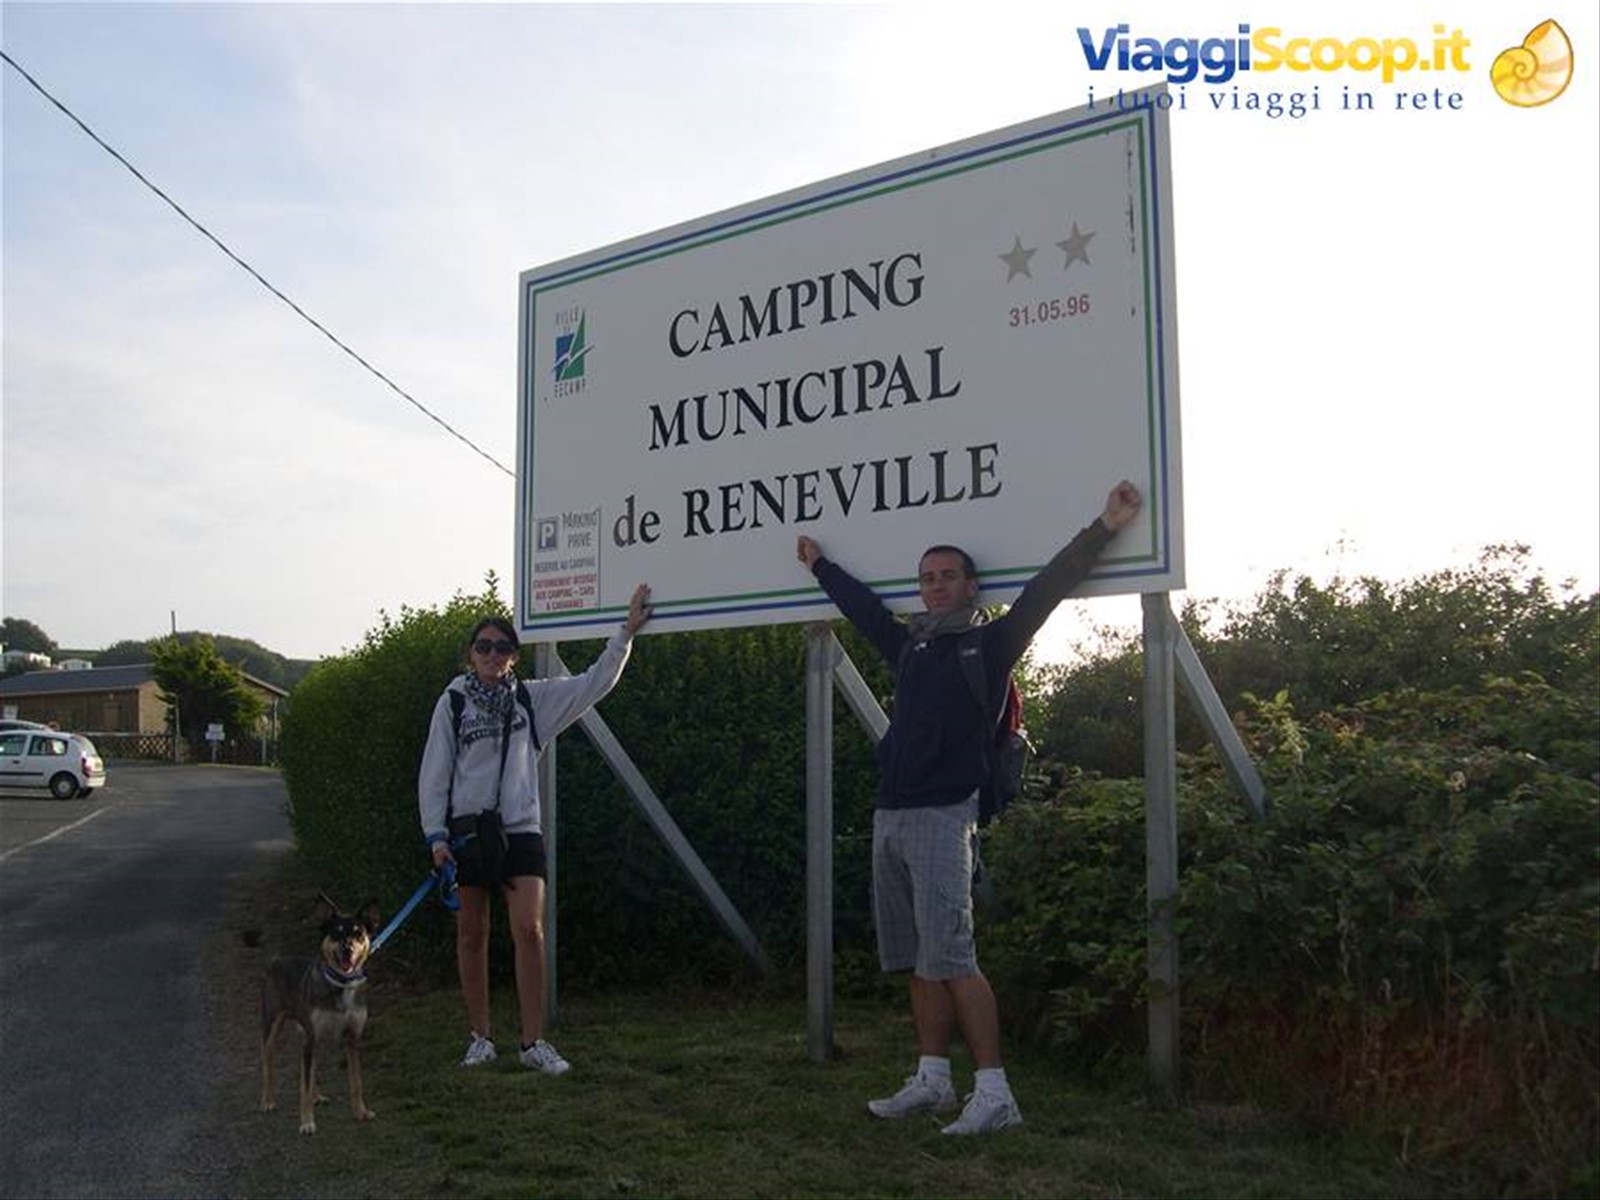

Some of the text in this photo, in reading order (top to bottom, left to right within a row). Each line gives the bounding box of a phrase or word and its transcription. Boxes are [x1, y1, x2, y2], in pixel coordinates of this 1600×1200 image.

[668, 253, 925, 358] CAMPING
[1008, 294, 1091, 328] 31.05.96
[648, 346, 962, 451] MUNICIPAL
[613, 443, 1003, 547] de RENEVILLE
